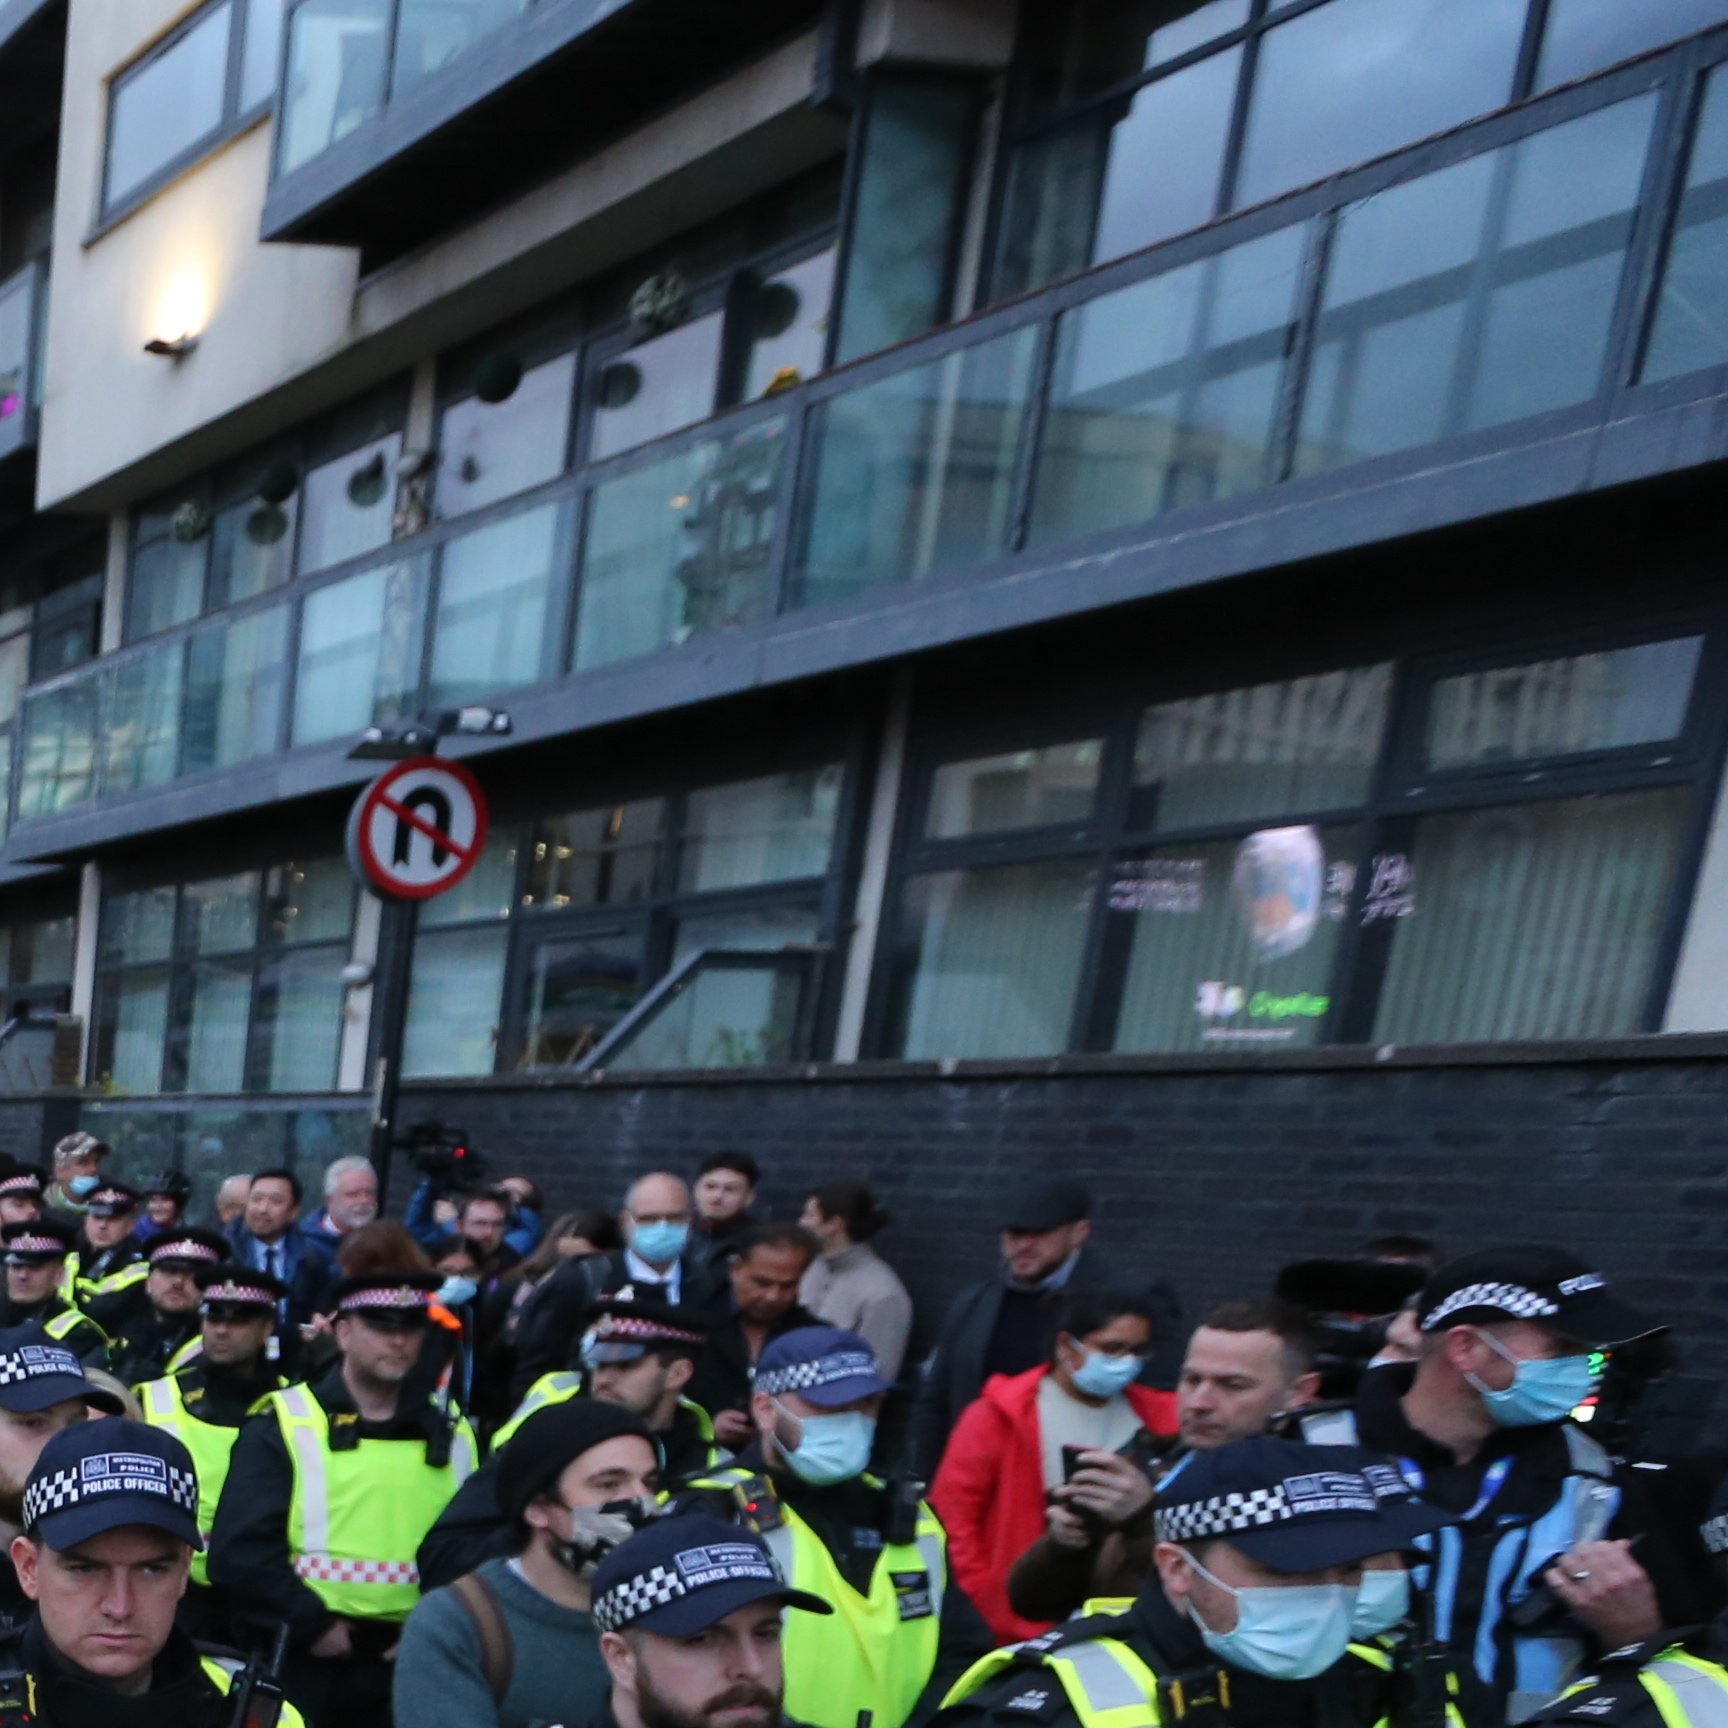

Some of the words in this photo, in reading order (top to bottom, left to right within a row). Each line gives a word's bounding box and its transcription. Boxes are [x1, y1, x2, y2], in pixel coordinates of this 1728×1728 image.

[119, 1464, 156, 1475] POLICE
[82, 1477, 123, 1496] POLICE
[123, 1476, 168, 1495] OFFICER
[685, 1566, 730, 1589] POLICE
